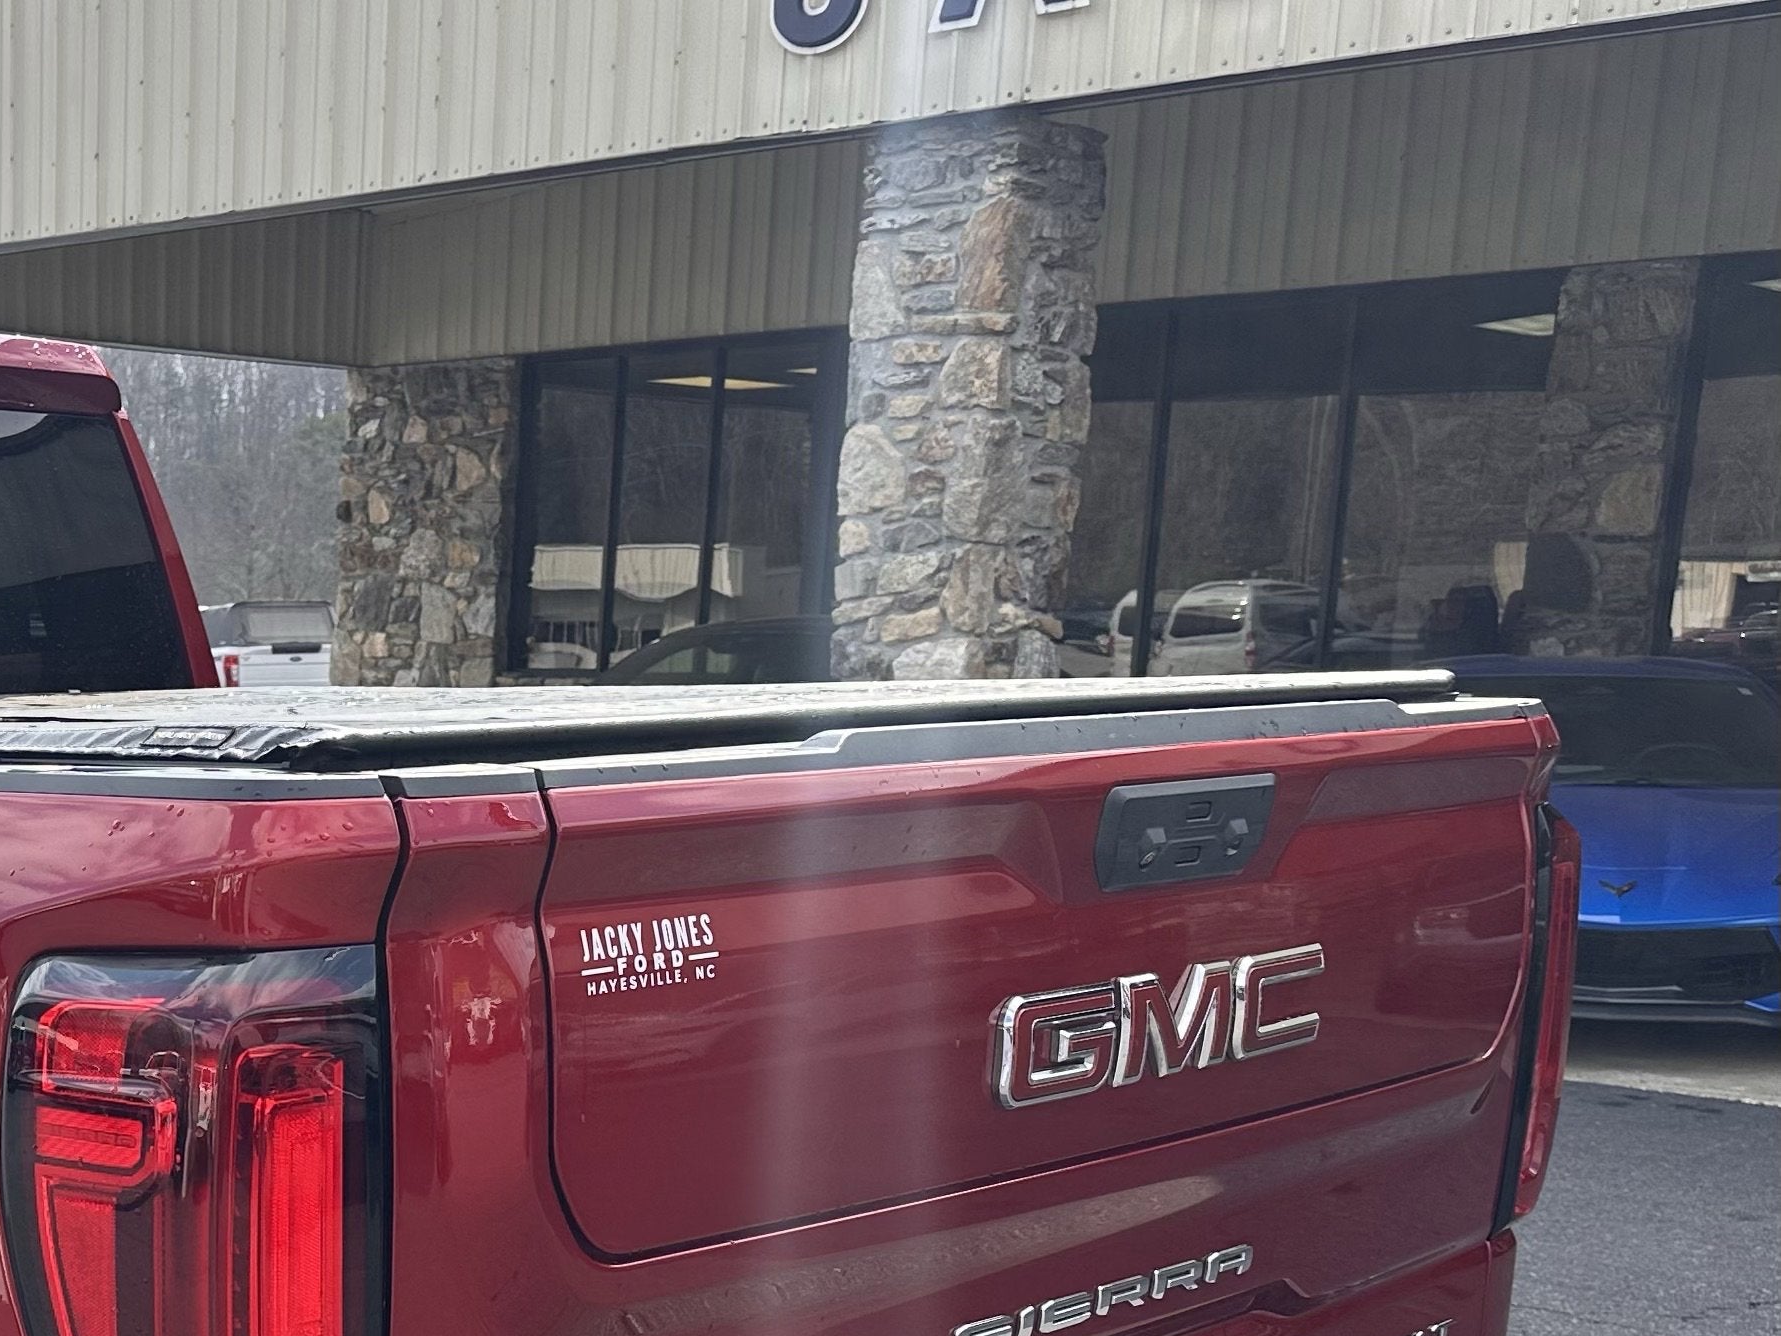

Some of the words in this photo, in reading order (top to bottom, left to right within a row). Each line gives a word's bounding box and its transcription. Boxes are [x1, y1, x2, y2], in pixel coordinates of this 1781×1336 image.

[580, 922, 644, 963] JACKY
[652, 913, 714, 952] JONES
[586, 968, 689, 997] HAYESVILLE,
[695, 964, 716, 980] NC
[616, 949, 684, 976] FORD
[988, 943, 1325, 1110] GMC
